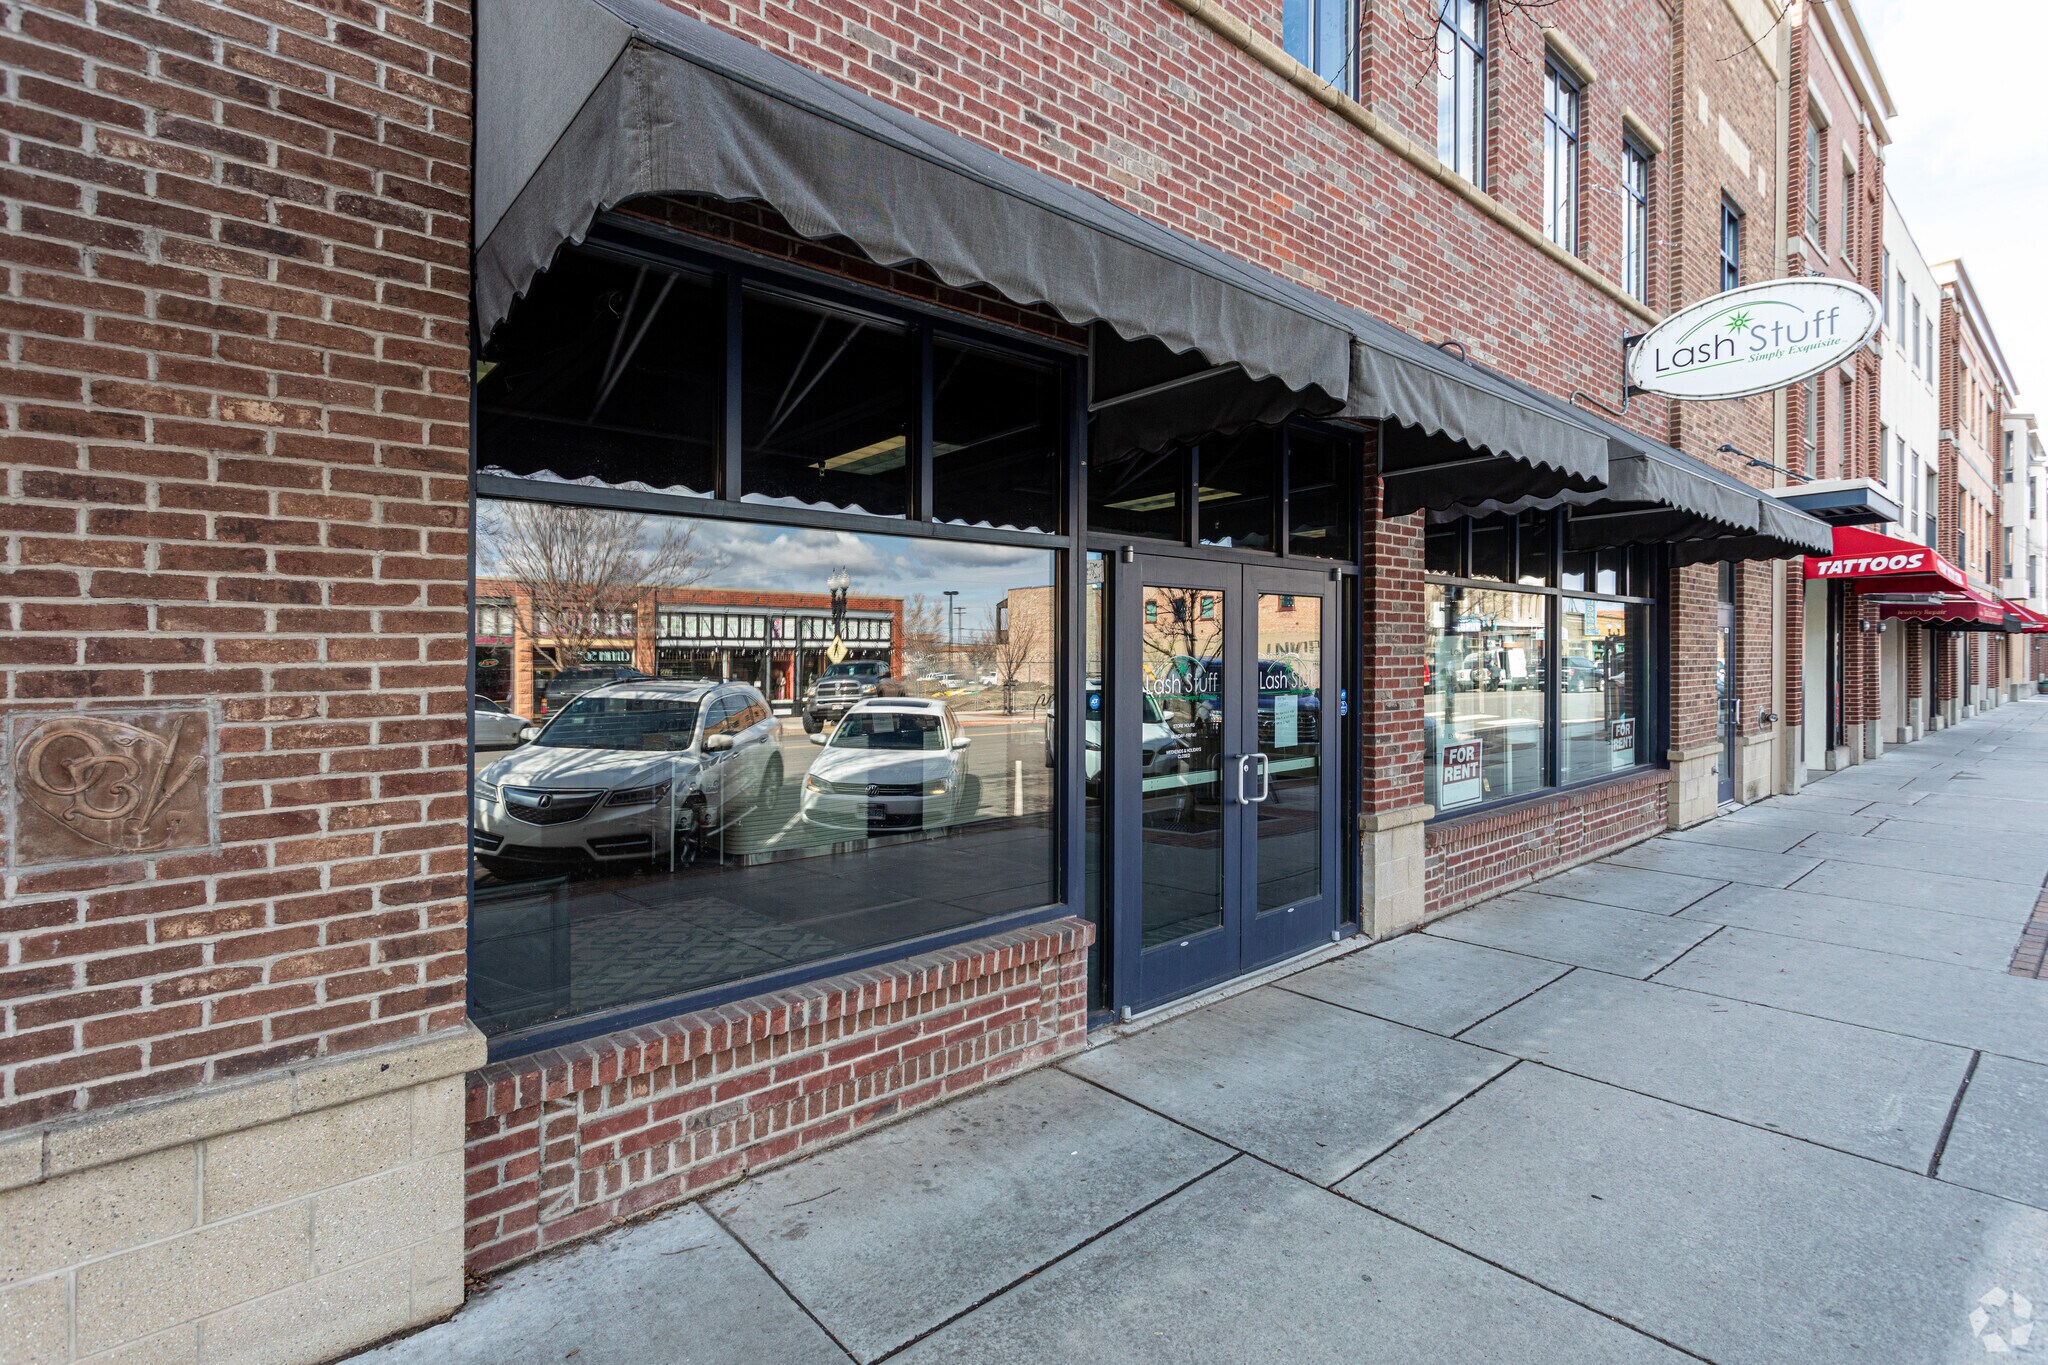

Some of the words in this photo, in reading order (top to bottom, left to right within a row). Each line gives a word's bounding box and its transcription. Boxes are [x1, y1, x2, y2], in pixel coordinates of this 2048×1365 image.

[1654, 334, 1735, 373] Lash
[1748, 306, 1840, 352] Stuff
[1747, 349, 1786, 364] Simply
[1787, 337, 1842, 356] Exquisite
[1817, 553, 1925, 576] TATTOOS
[1146, 673, 1181, 695] Lash
[1185, 672, 1218, 693] Stuff
[1259, 670, 1288, 690] Lash
[1615, 723, 1631, 737] FOR
[1613, 735, 1633, 751] RENT
[1448, 745, 1475, 765] FOR
[1444, 761, 1479, 783] RENT
